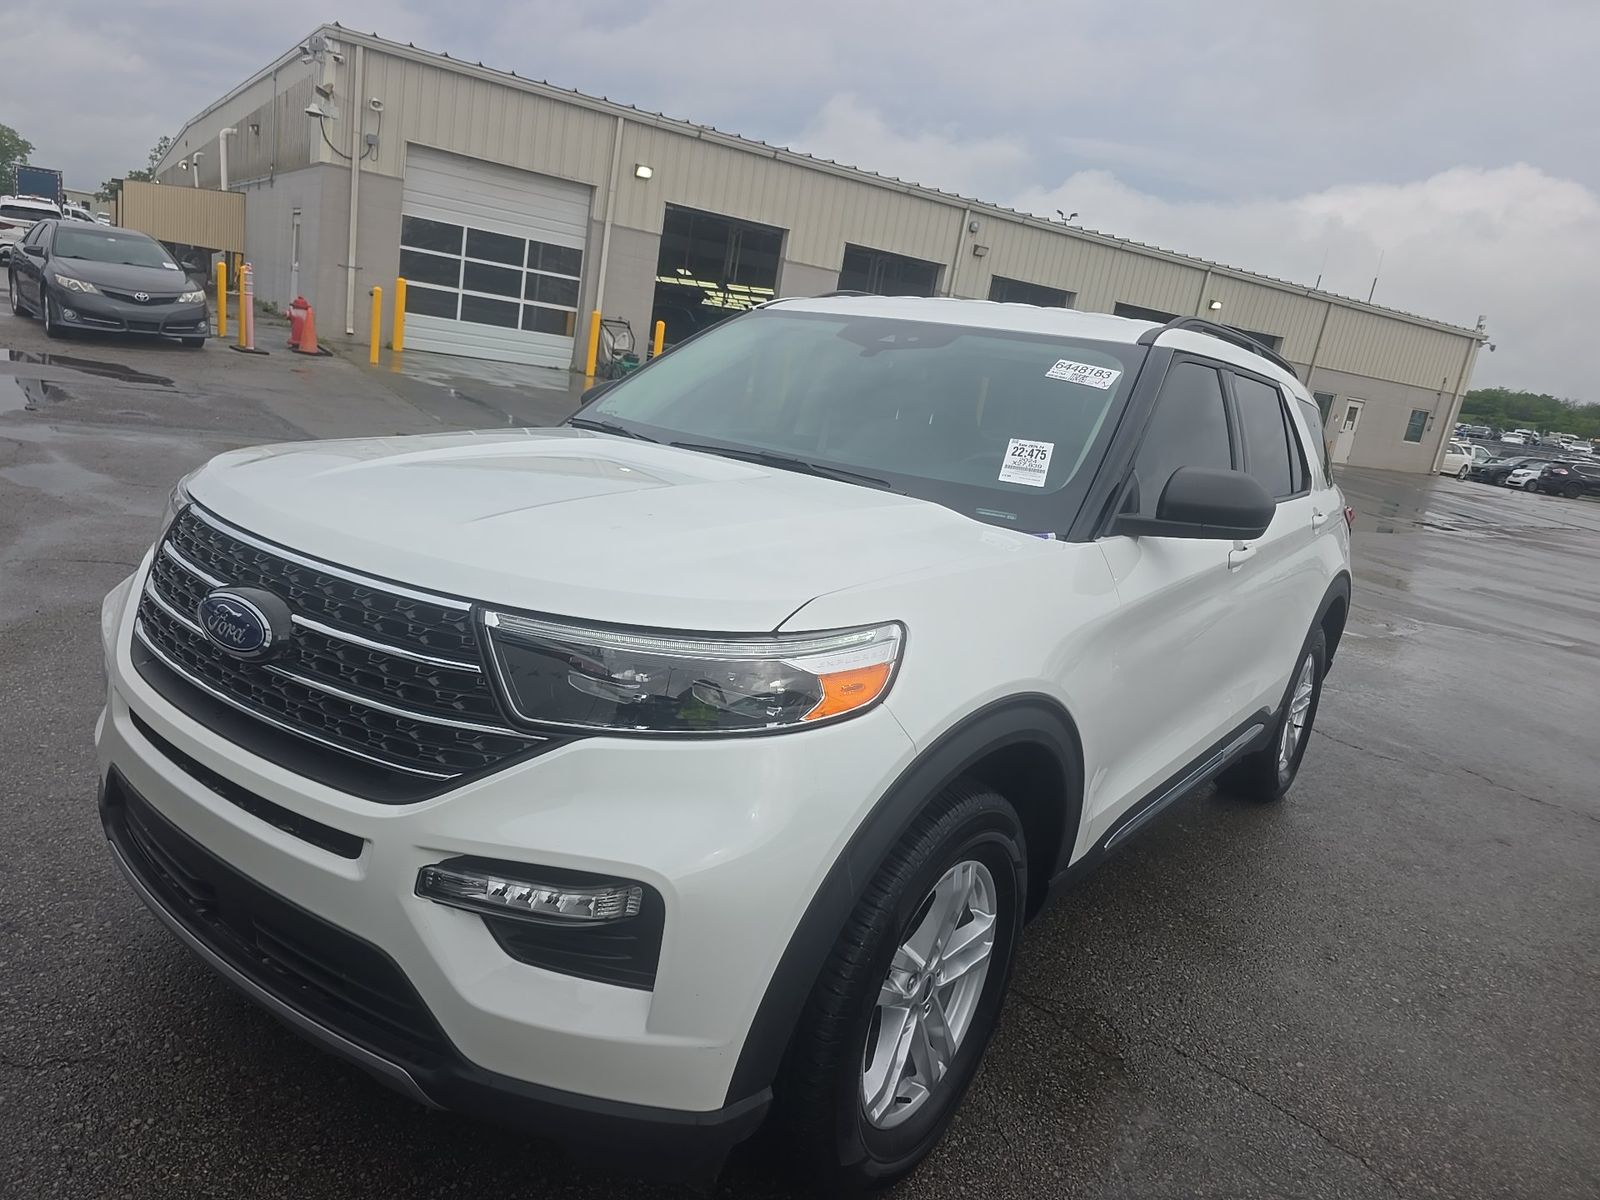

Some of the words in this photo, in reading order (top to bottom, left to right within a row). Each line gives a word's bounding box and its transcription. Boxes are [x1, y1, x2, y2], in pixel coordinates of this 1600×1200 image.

[1055, 361, 1112, 379] 6448183
[1011, 446, 1048, 460] 22:475
[207, 603, 249, 644] Ford
